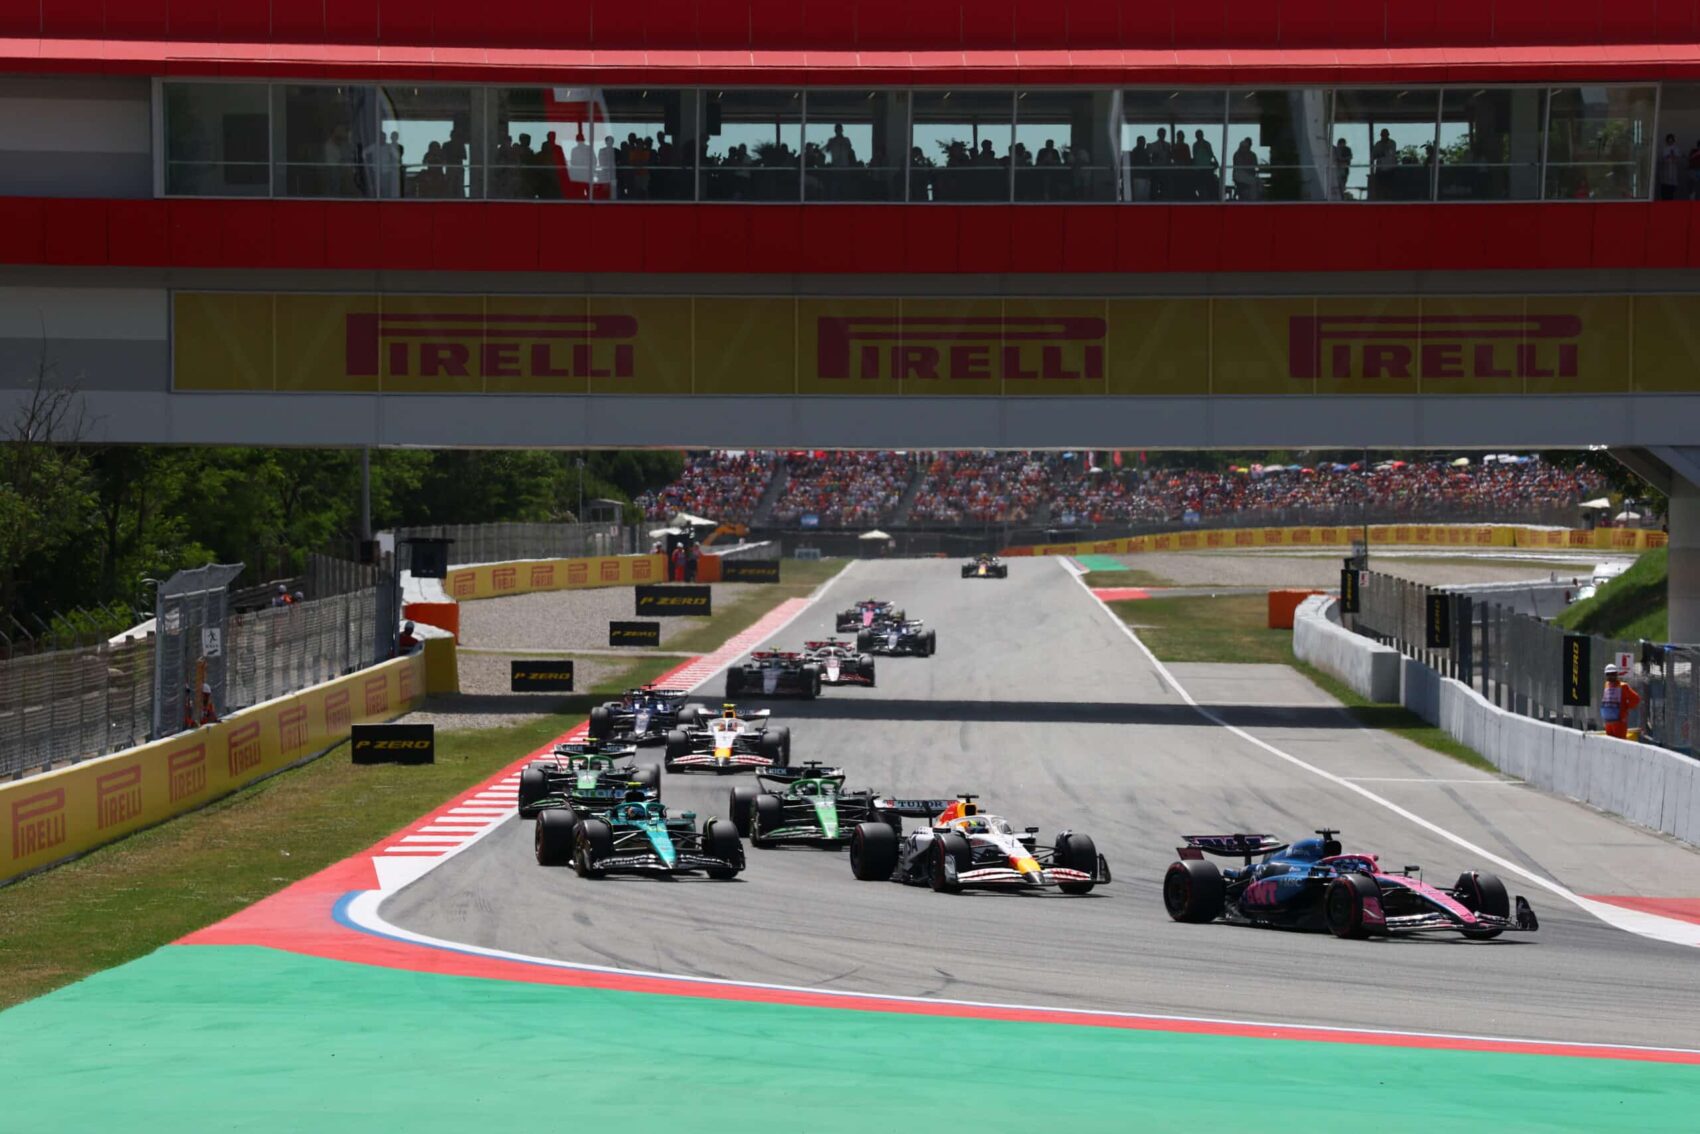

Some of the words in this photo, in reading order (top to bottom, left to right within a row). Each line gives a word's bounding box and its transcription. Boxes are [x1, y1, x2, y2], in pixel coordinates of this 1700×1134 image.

[345, 313, 638, 378] PIRELLI
[817, 316, 1107, 380] PIRELLI
[1289, 314, 1582, 379] PIRELLI
[640, 597, 654, 605] P
[656, 597, 707, 605] ZERO
[514, 672, 525, 680] P
[529, 672, 570, 680] ZERO
[1572, 687, 1578, 700] P
[168, 742, 206, 804] PIRELLI
[228, 720, 262, 778] PIRELLI
[355, 741, 370, 749] P
[372, 741, 431, 749] ZERO
[11, 787, 66, 860] PIRELLI
[96, 763, 142, 830] PIRELLI
